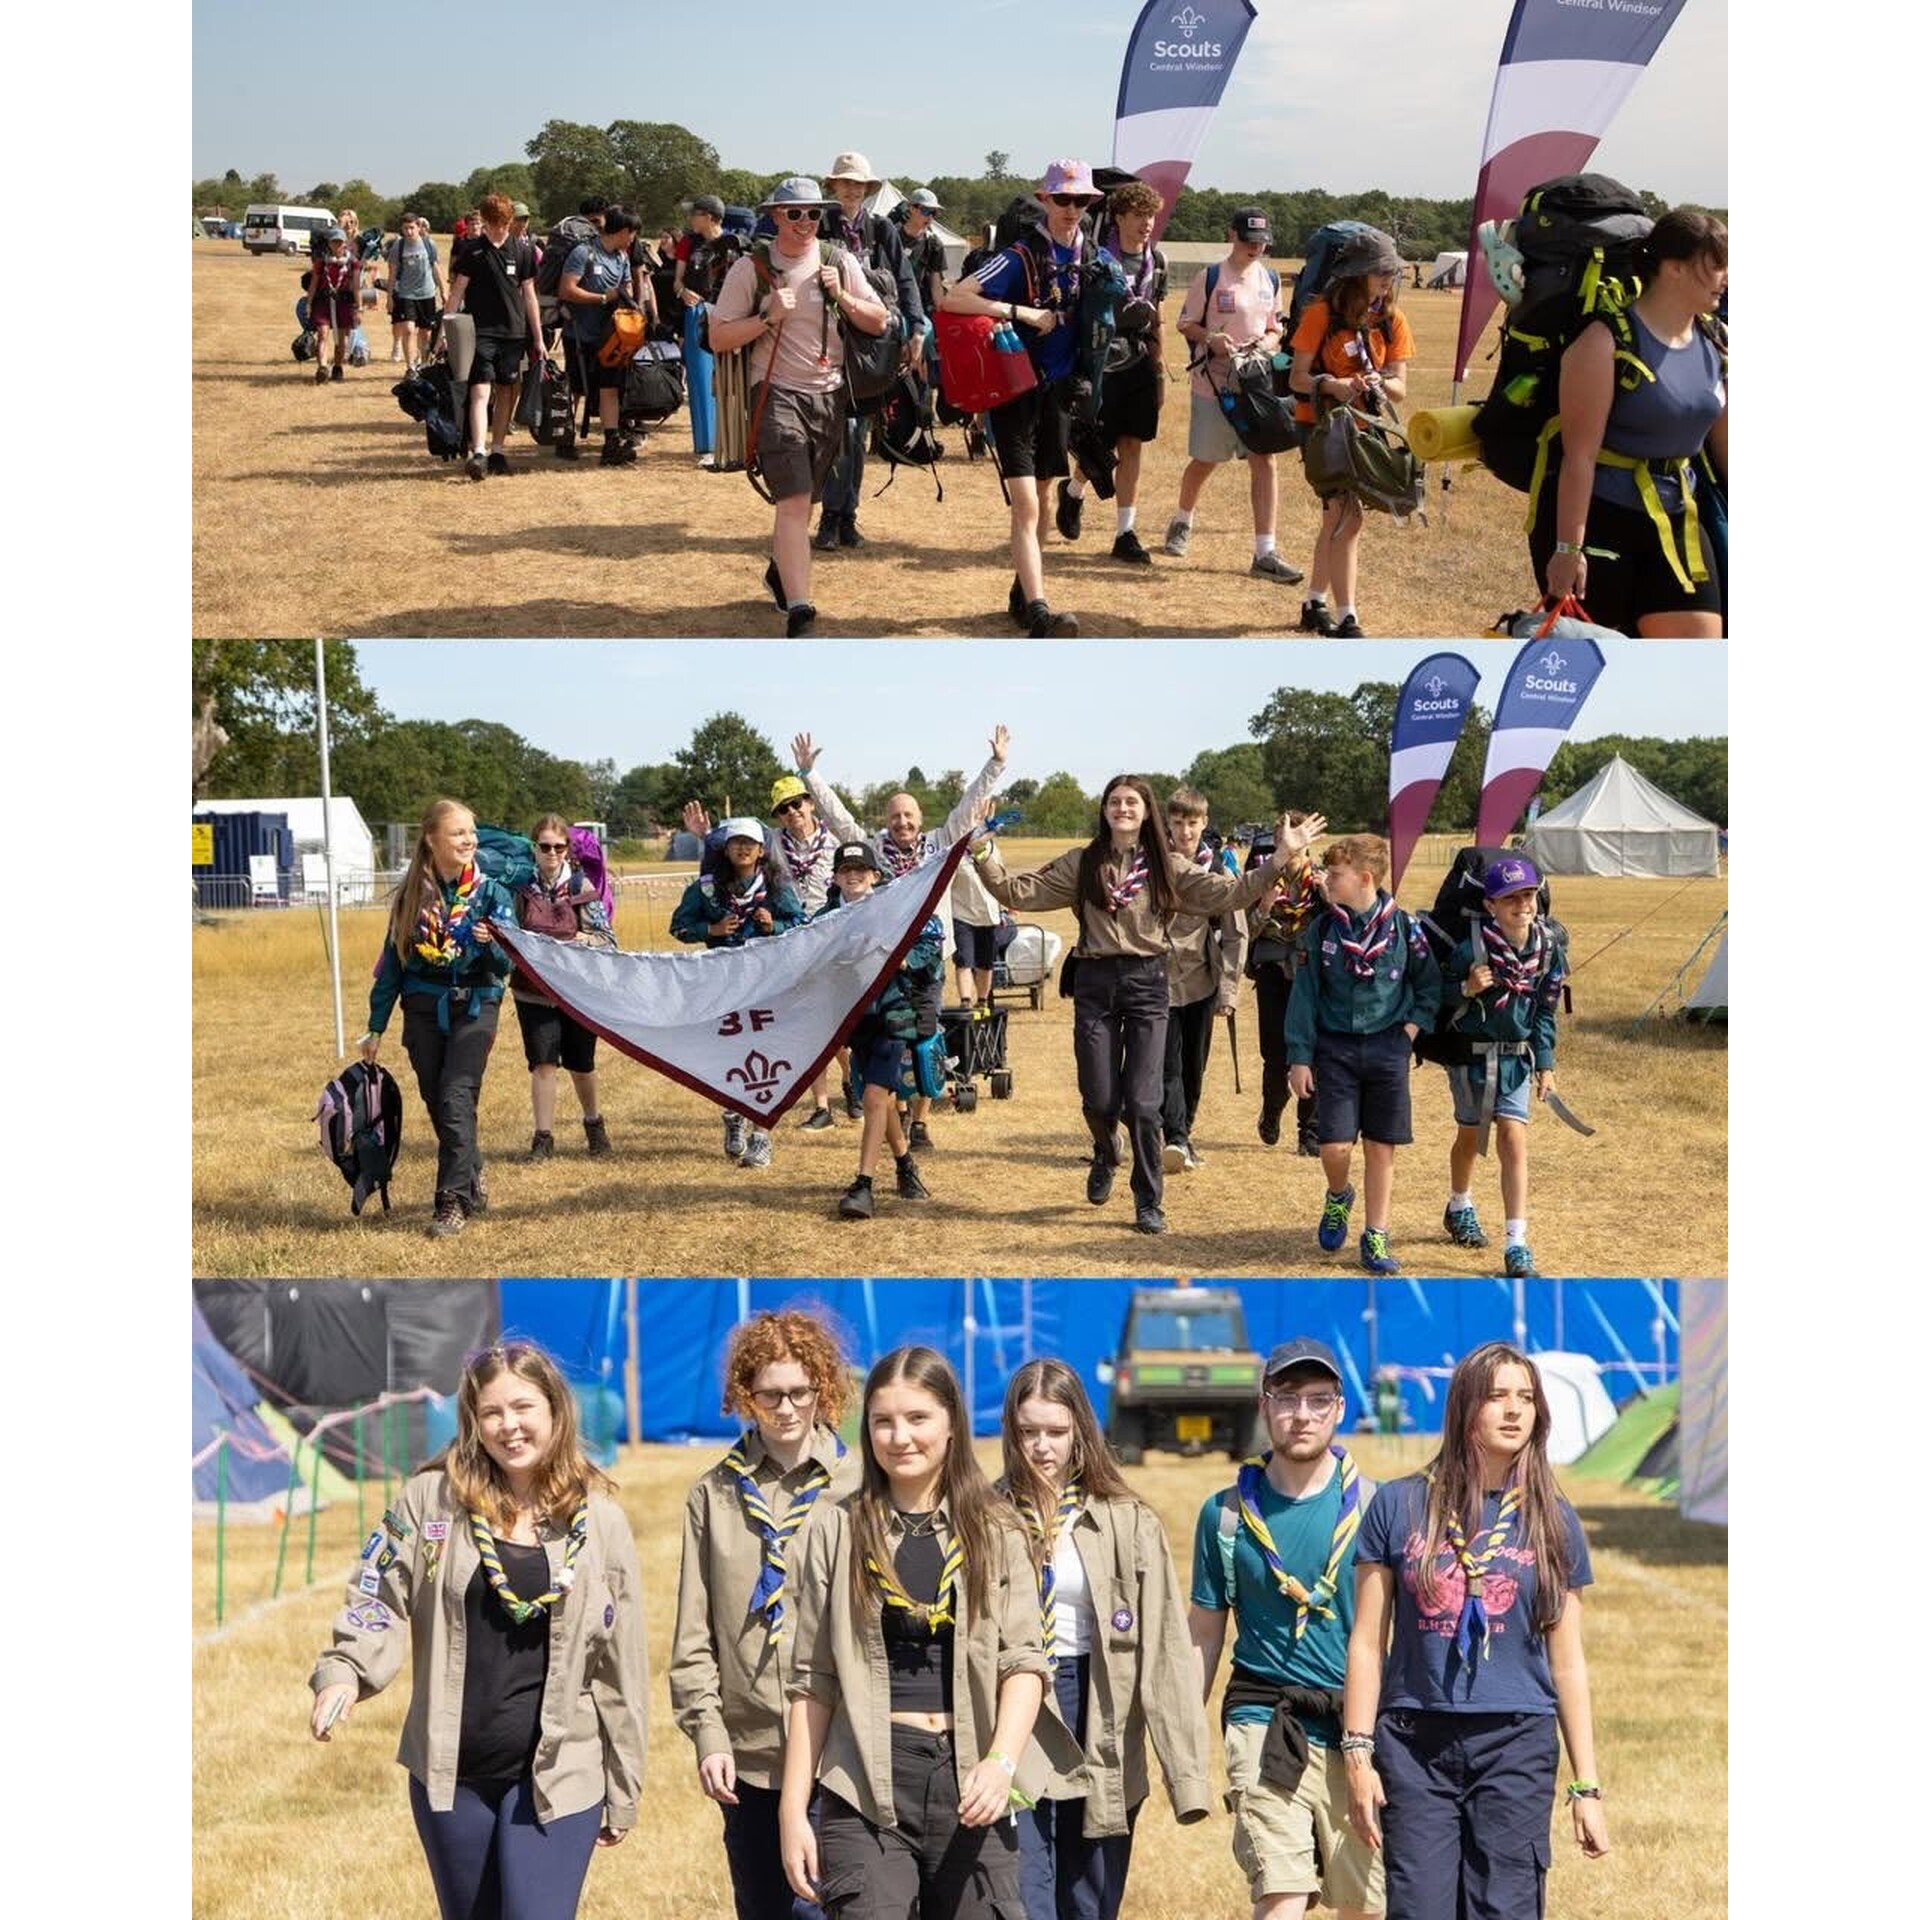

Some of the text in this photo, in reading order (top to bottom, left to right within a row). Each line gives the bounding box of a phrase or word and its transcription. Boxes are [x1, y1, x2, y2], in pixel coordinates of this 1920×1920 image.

[1153, 41, 1221, 58] Scouts
[1149, 62, 1183, 72] Central
[1525, 675, 1577, 693] Scouts
[1414, 698, 1459, 711] Scouts
